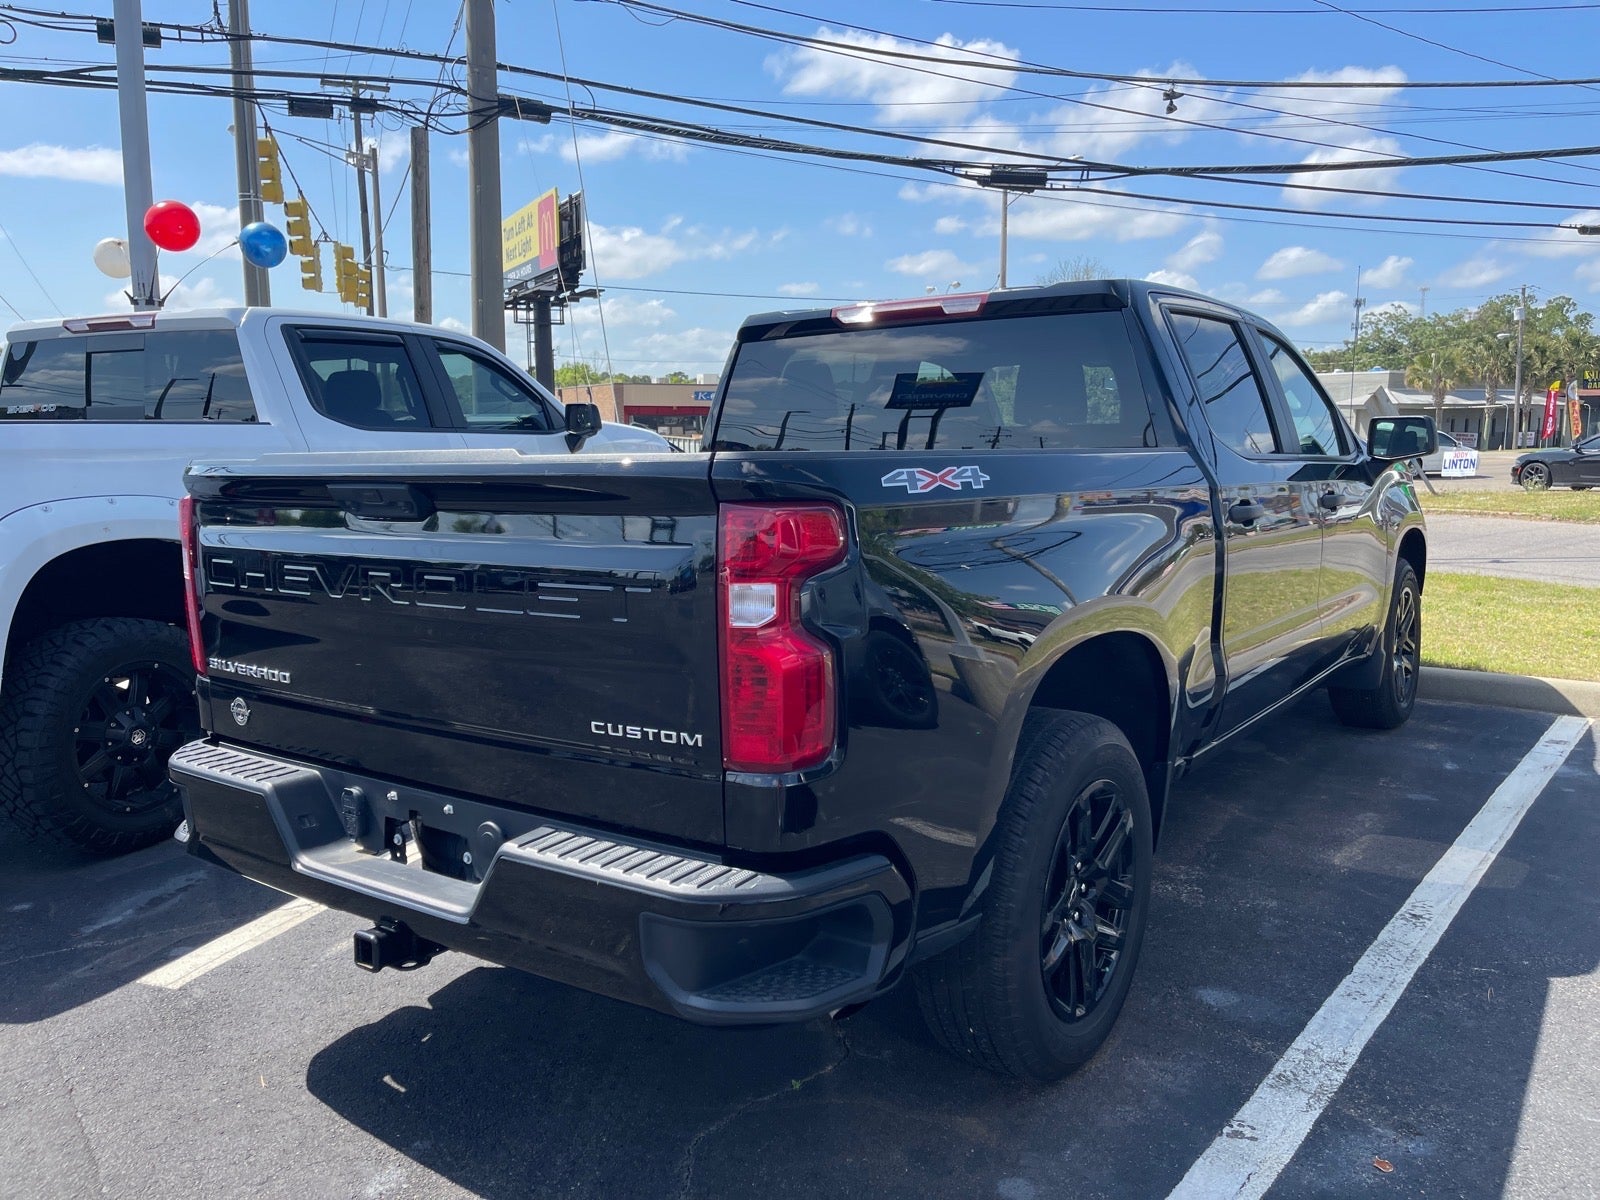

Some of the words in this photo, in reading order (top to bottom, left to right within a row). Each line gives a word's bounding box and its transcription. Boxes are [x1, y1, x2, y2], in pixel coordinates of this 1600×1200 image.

[503, 226, 514, 242] Turn
[515, 215, 526, 237] Left
[526, 210, 533, 230] At
[505, 242, 517, 263] Next
[517, 235, 532, 258] Light
[520, 263, 532, 277] HOURS
[1443, 458, 1476, 470] LINTON
[205, 553, 656, 623] CHEVROLET
[208, 657, 291, 684] SILVERADO
[590, 720, 703, 747] CUSTOM
